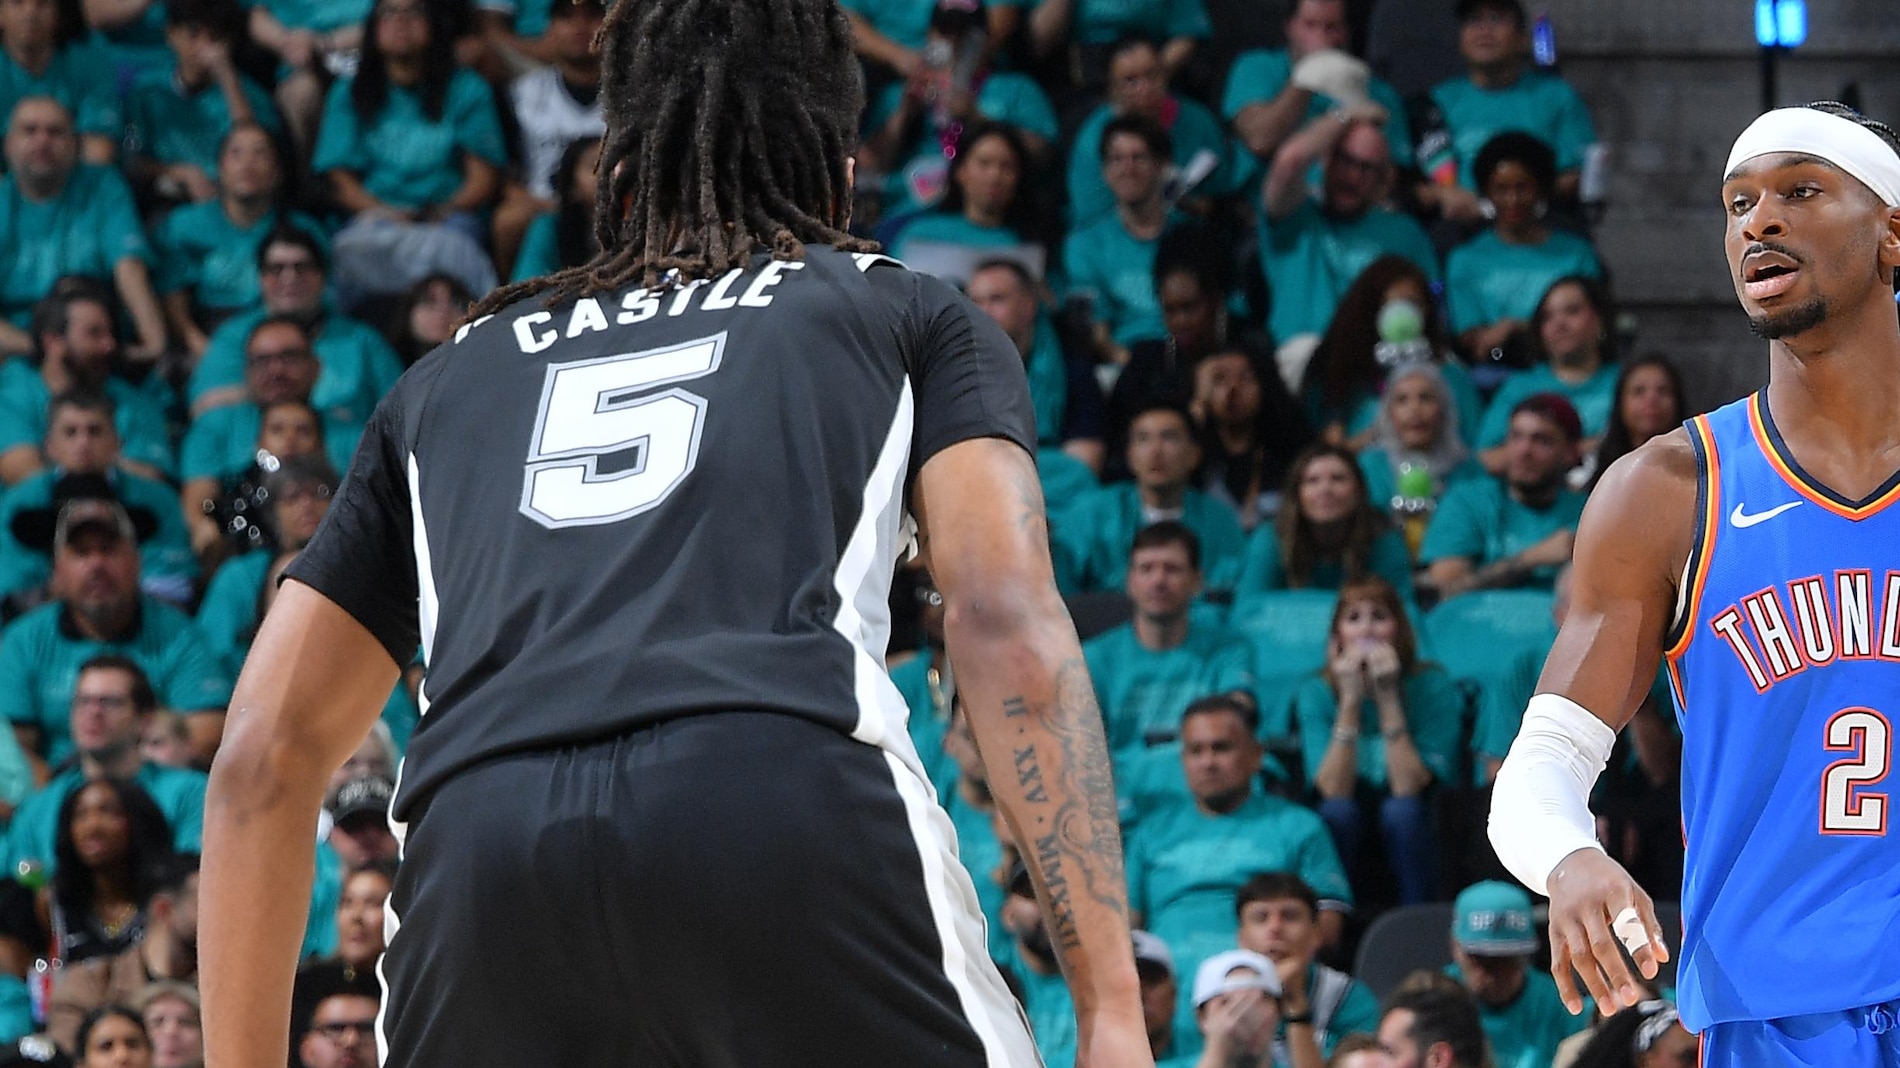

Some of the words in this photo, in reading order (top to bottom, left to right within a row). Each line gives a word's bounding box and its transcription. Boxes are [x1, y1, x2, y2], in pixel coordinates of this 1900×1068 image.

[512, 260, 805, 353] CASTLE
[518, 330, 728, 529] 5
[1014, 744, 1048, 804] XXV
[1818, 706, 1893, 836] 2
